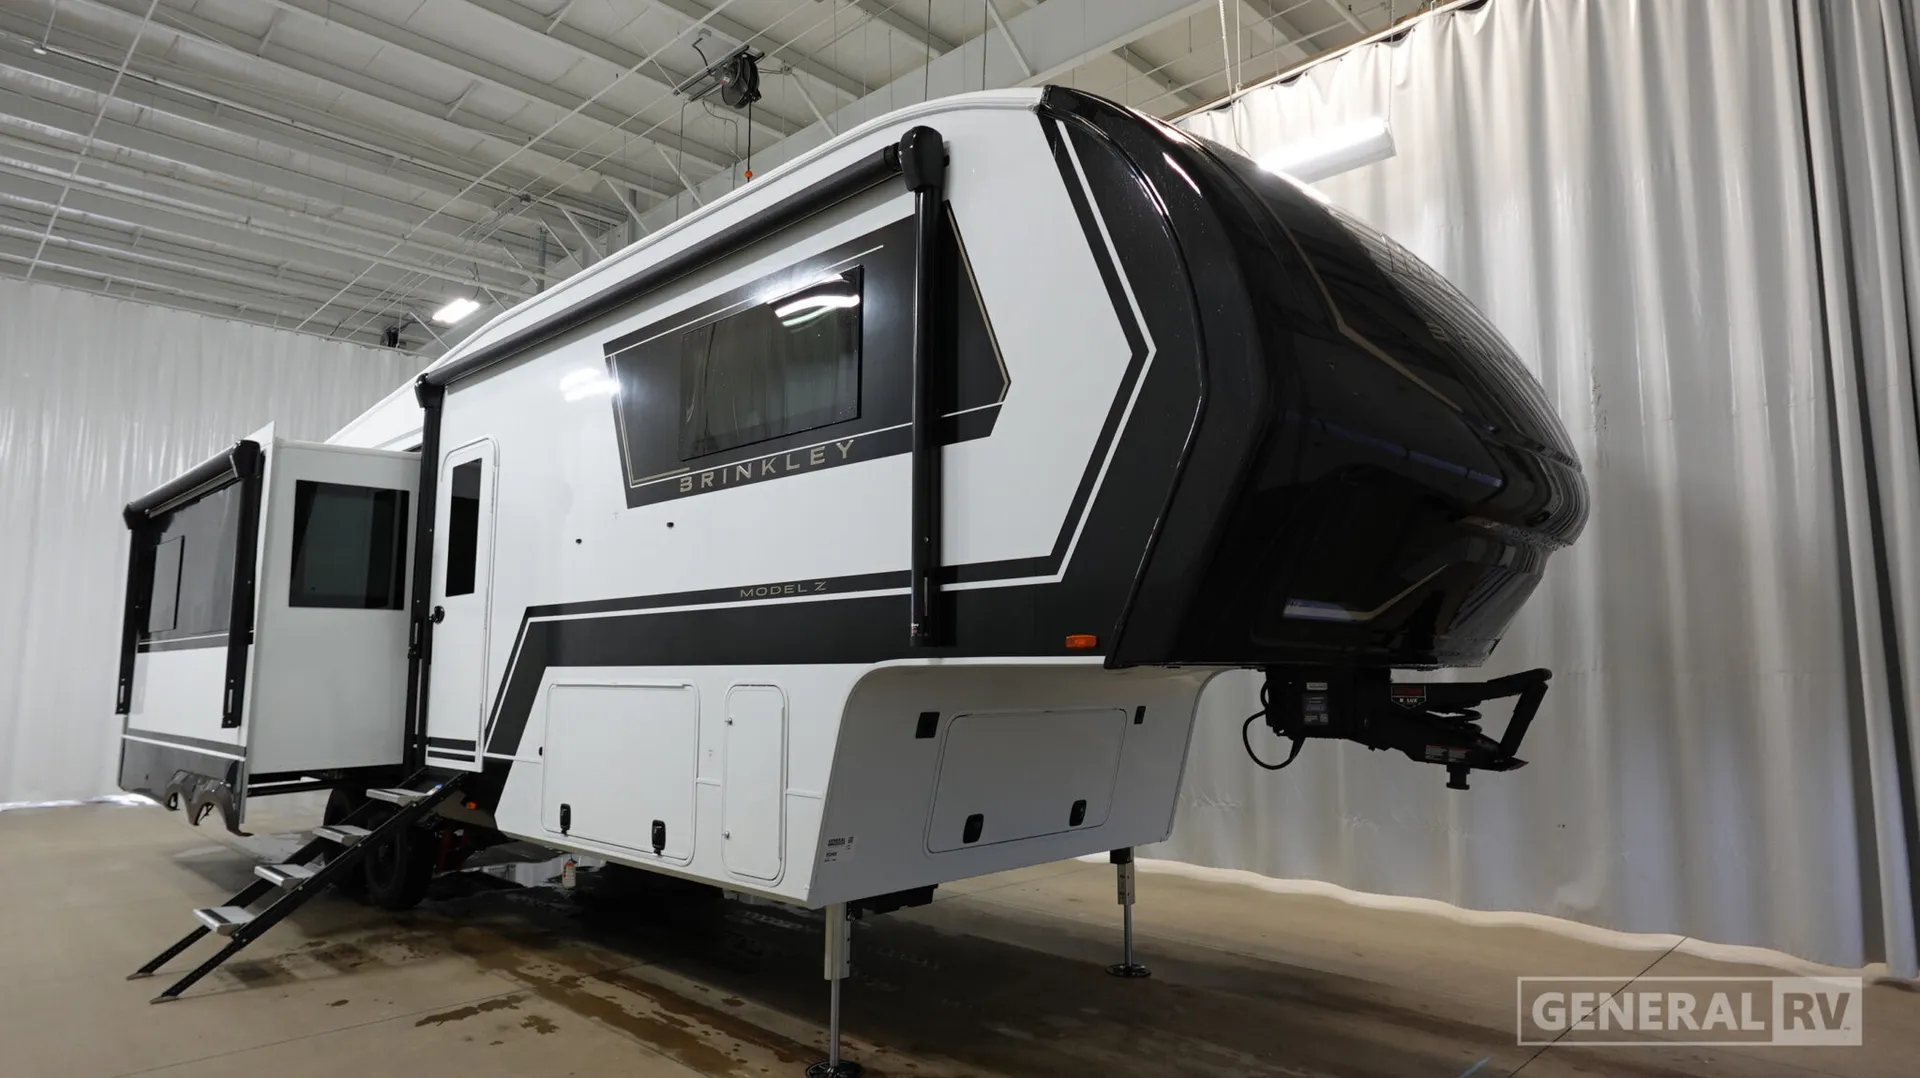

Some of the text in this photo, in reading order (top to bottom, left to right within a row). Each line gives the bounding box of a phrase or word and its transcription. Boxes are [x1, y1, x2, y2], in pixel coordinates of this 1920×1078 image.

[679, 439, 855, 493] BRINKLEY
[739, 580, 828, 598] MODEL Z
